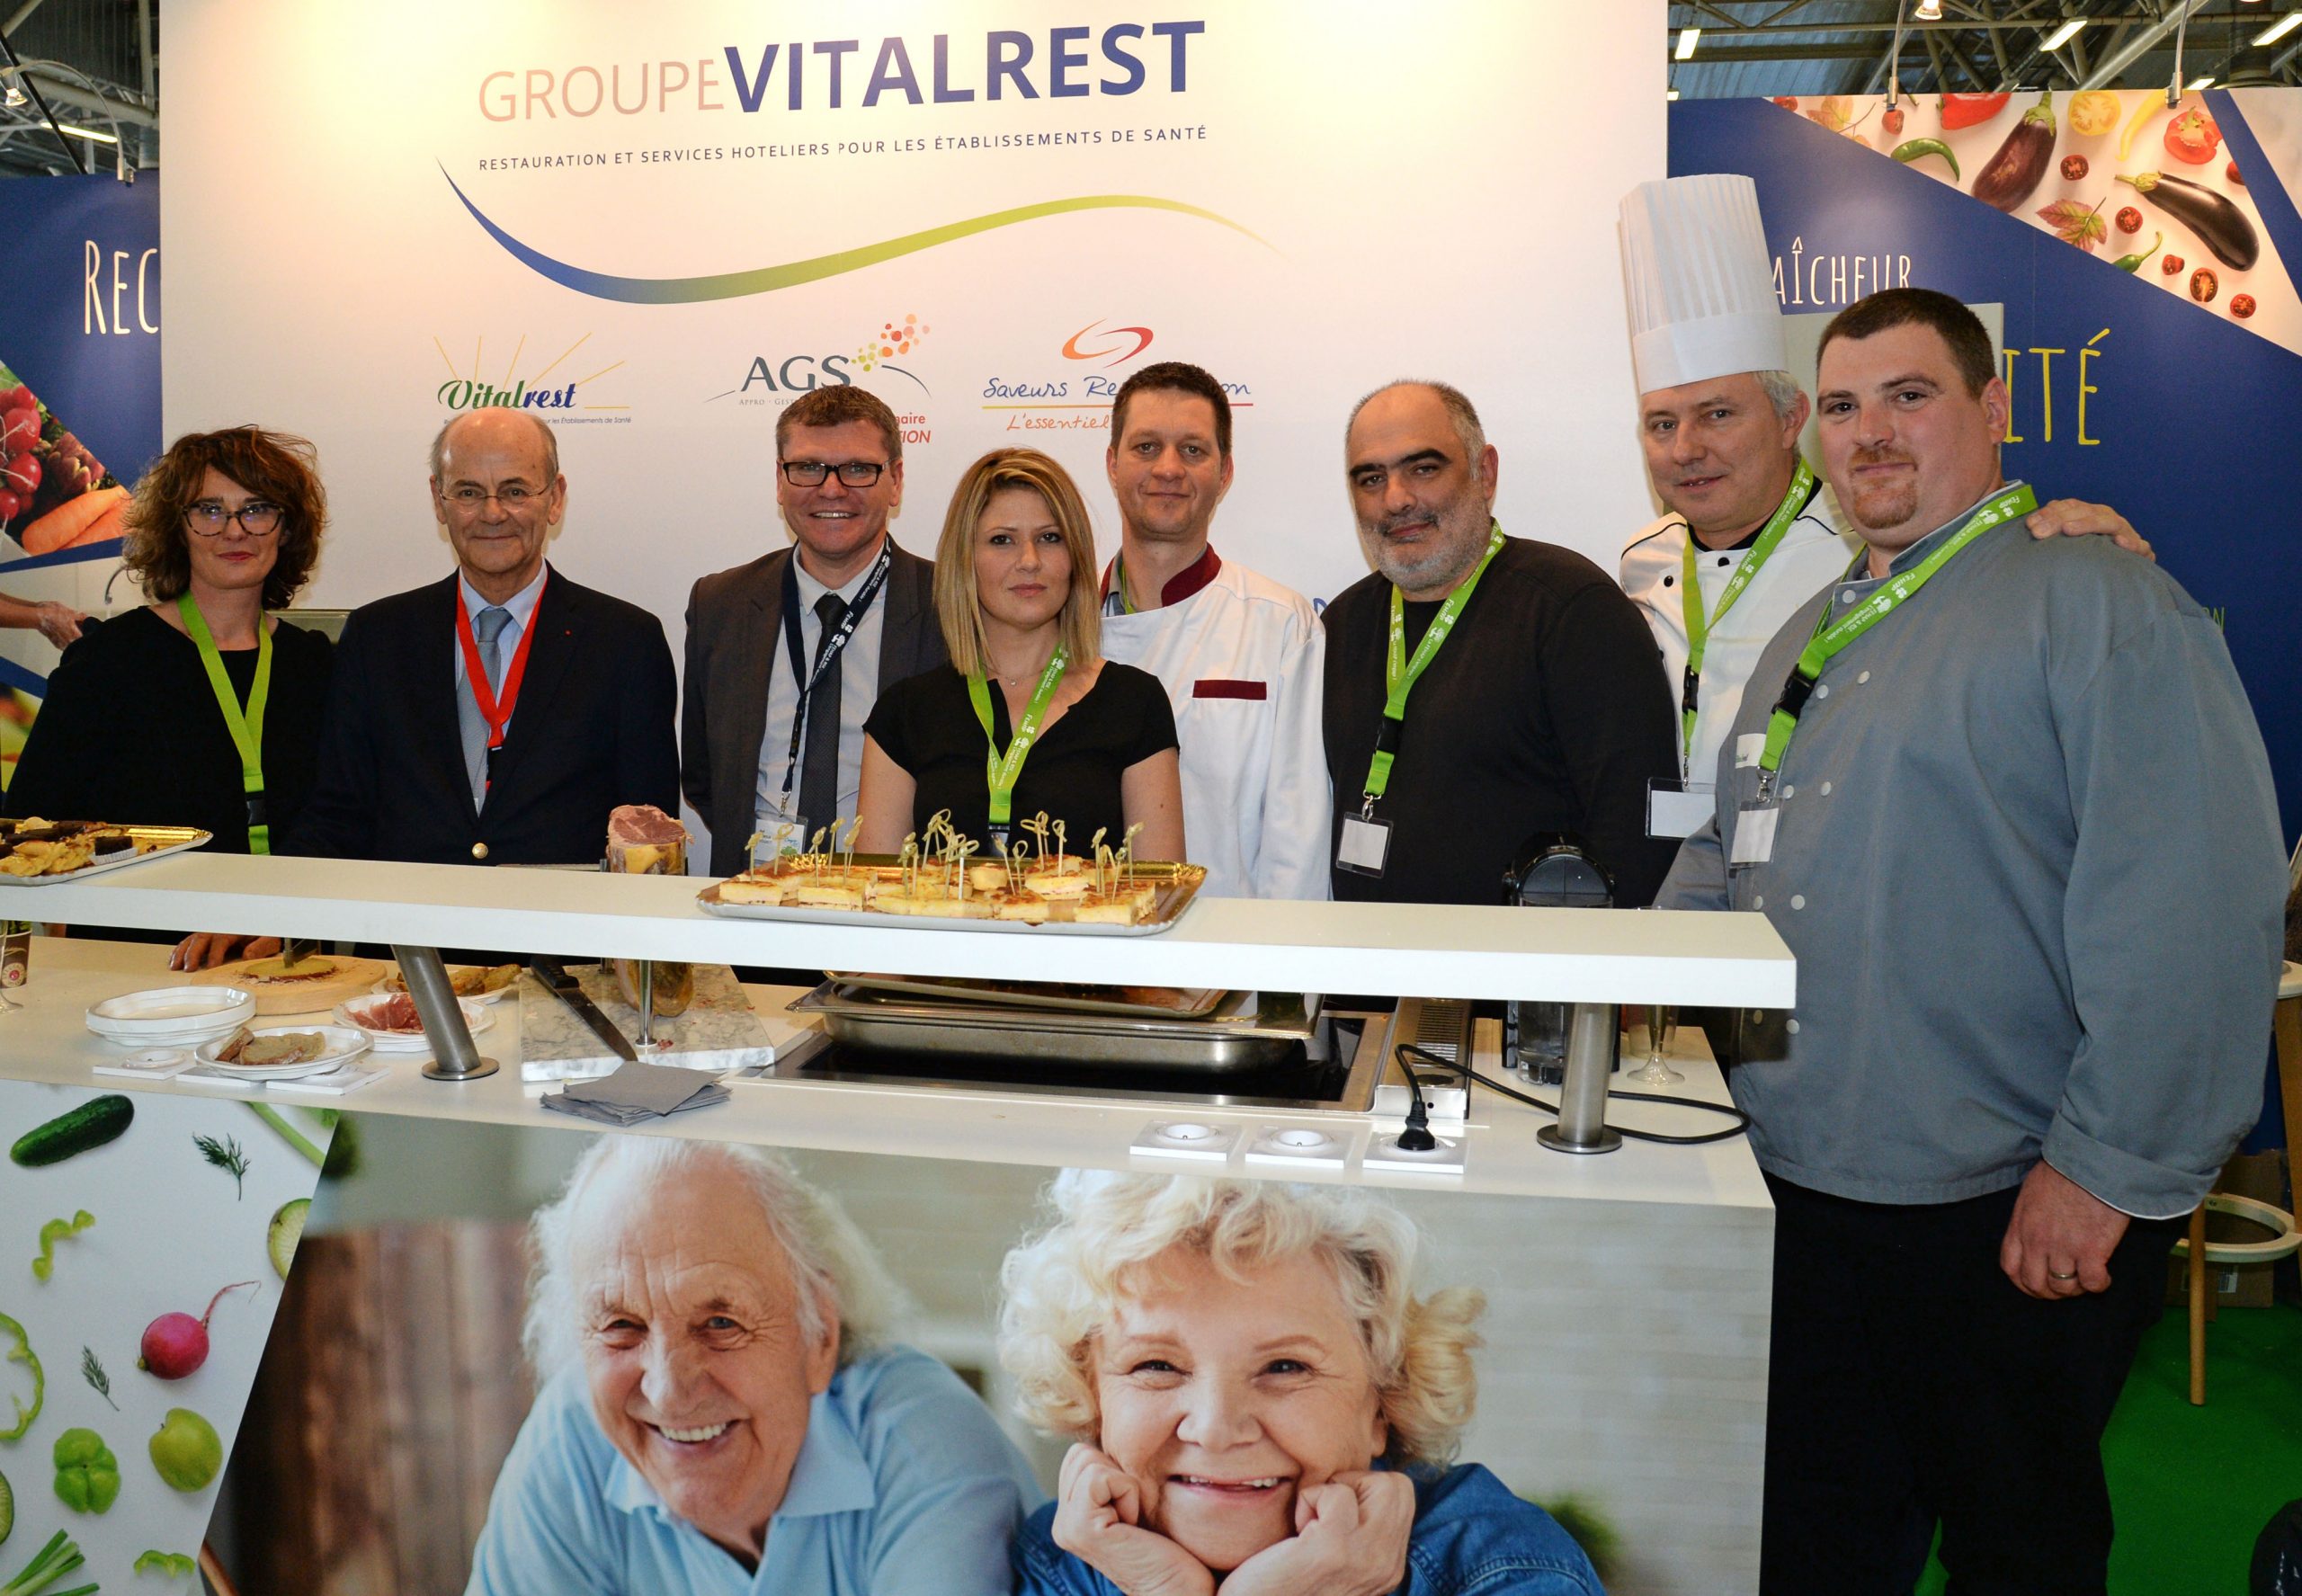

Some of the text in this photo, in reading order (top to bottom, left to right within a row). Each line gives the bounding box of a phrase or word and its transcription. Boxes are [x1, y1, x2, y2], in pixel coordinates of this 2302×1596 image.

[478, 124, 1208, 171] RESTAURATION ET SERVICES HOTELIERS POUR LES ÉTABLISSEMENTS DE SANTÉ
[85, 239, 159, 335] REC
[1772, 236, 1912, 306] AÎCHEUR
[740, 354, 852, 392] AGS
[983, 377, 1068, 398] Saveurs
[2002, 327, 2111, 446] ITÉ
[437, 379, 577, 410] Vitalrest
[1006, 413, 1111, 432] L'essentiel
